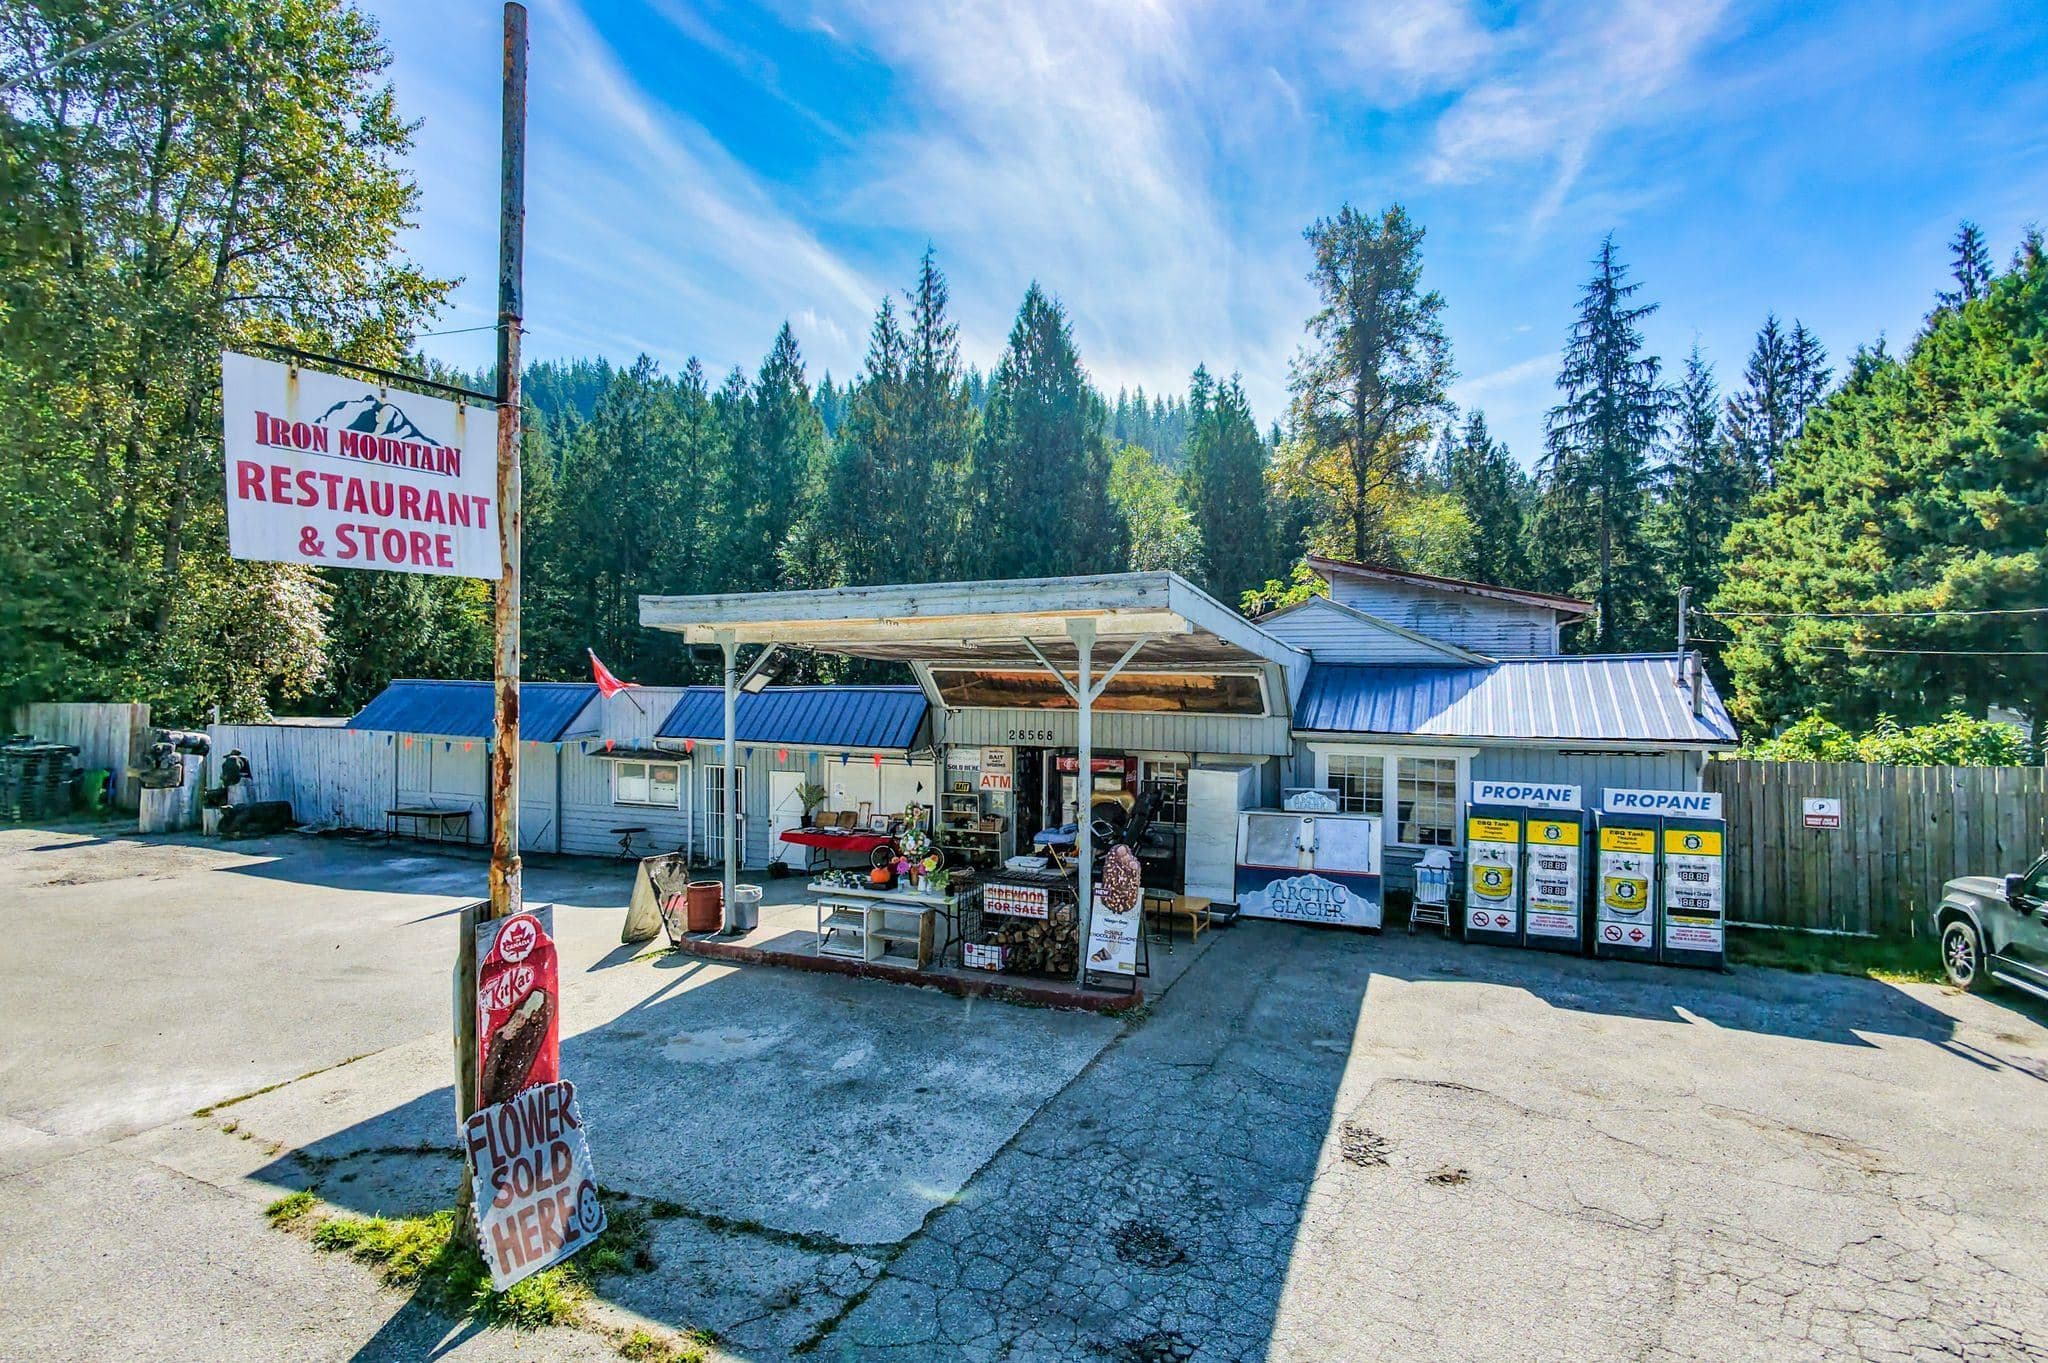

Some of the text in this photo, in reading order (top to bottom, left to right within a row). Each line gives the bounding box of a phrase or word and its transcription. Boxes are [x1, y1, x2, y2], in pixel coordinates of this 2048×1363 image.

[254, 410, 461, 478] IRON MOUNTAIN
[236, 460, 491, 529] RESTAURANT
[298, 523, 454, 568] & STORE
[1009, 730, 1053, 741] 28568
[981, 775, 1011, 789] ATM
[1481, 785, 1572, 802] PROPANE
[1612, 793, 1712, 811] PROPANE
[987, 901, 1045, 916] FOR SALE
[1271, 881, 1346, 904] ARCTIC
[1272, 900, 1346, 918] GLACIER
[489, 968, 532, 1009] KitKat
[467, 1081, 579, 1177] FLOWER
[490, 1140, 573, 1209] SOLD
[491, 1186, 581, 1276] HERE
